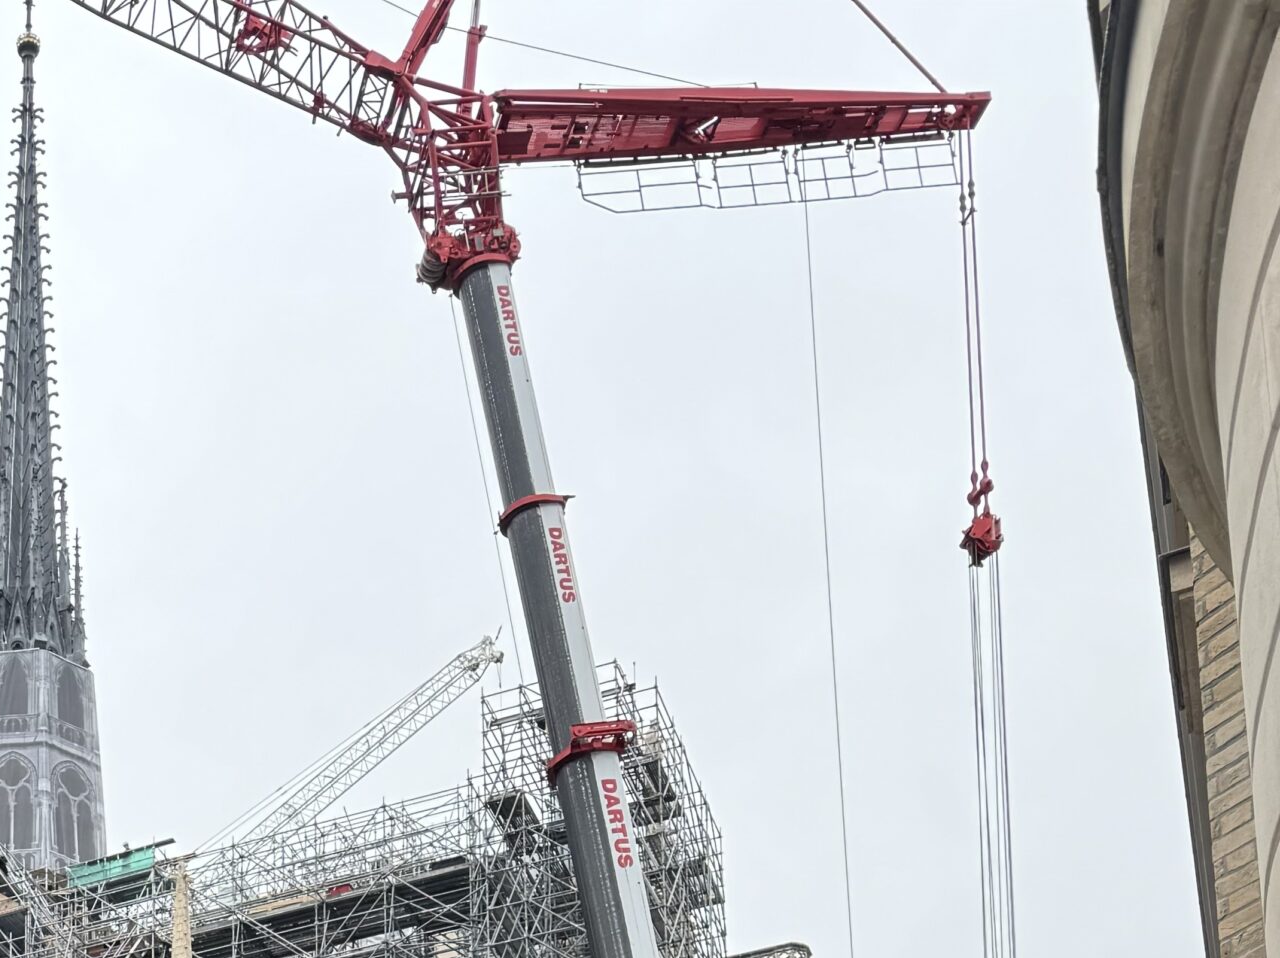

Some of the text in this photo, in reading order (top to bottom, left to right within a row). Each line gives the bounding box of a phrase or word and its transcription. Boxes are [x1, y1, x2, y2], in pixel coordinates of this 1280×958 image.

[497, 285, 522, 356] DARTUS
[548, 527, 575, 603] DARTUS
[601, 778, 633, 868] DARTUS
